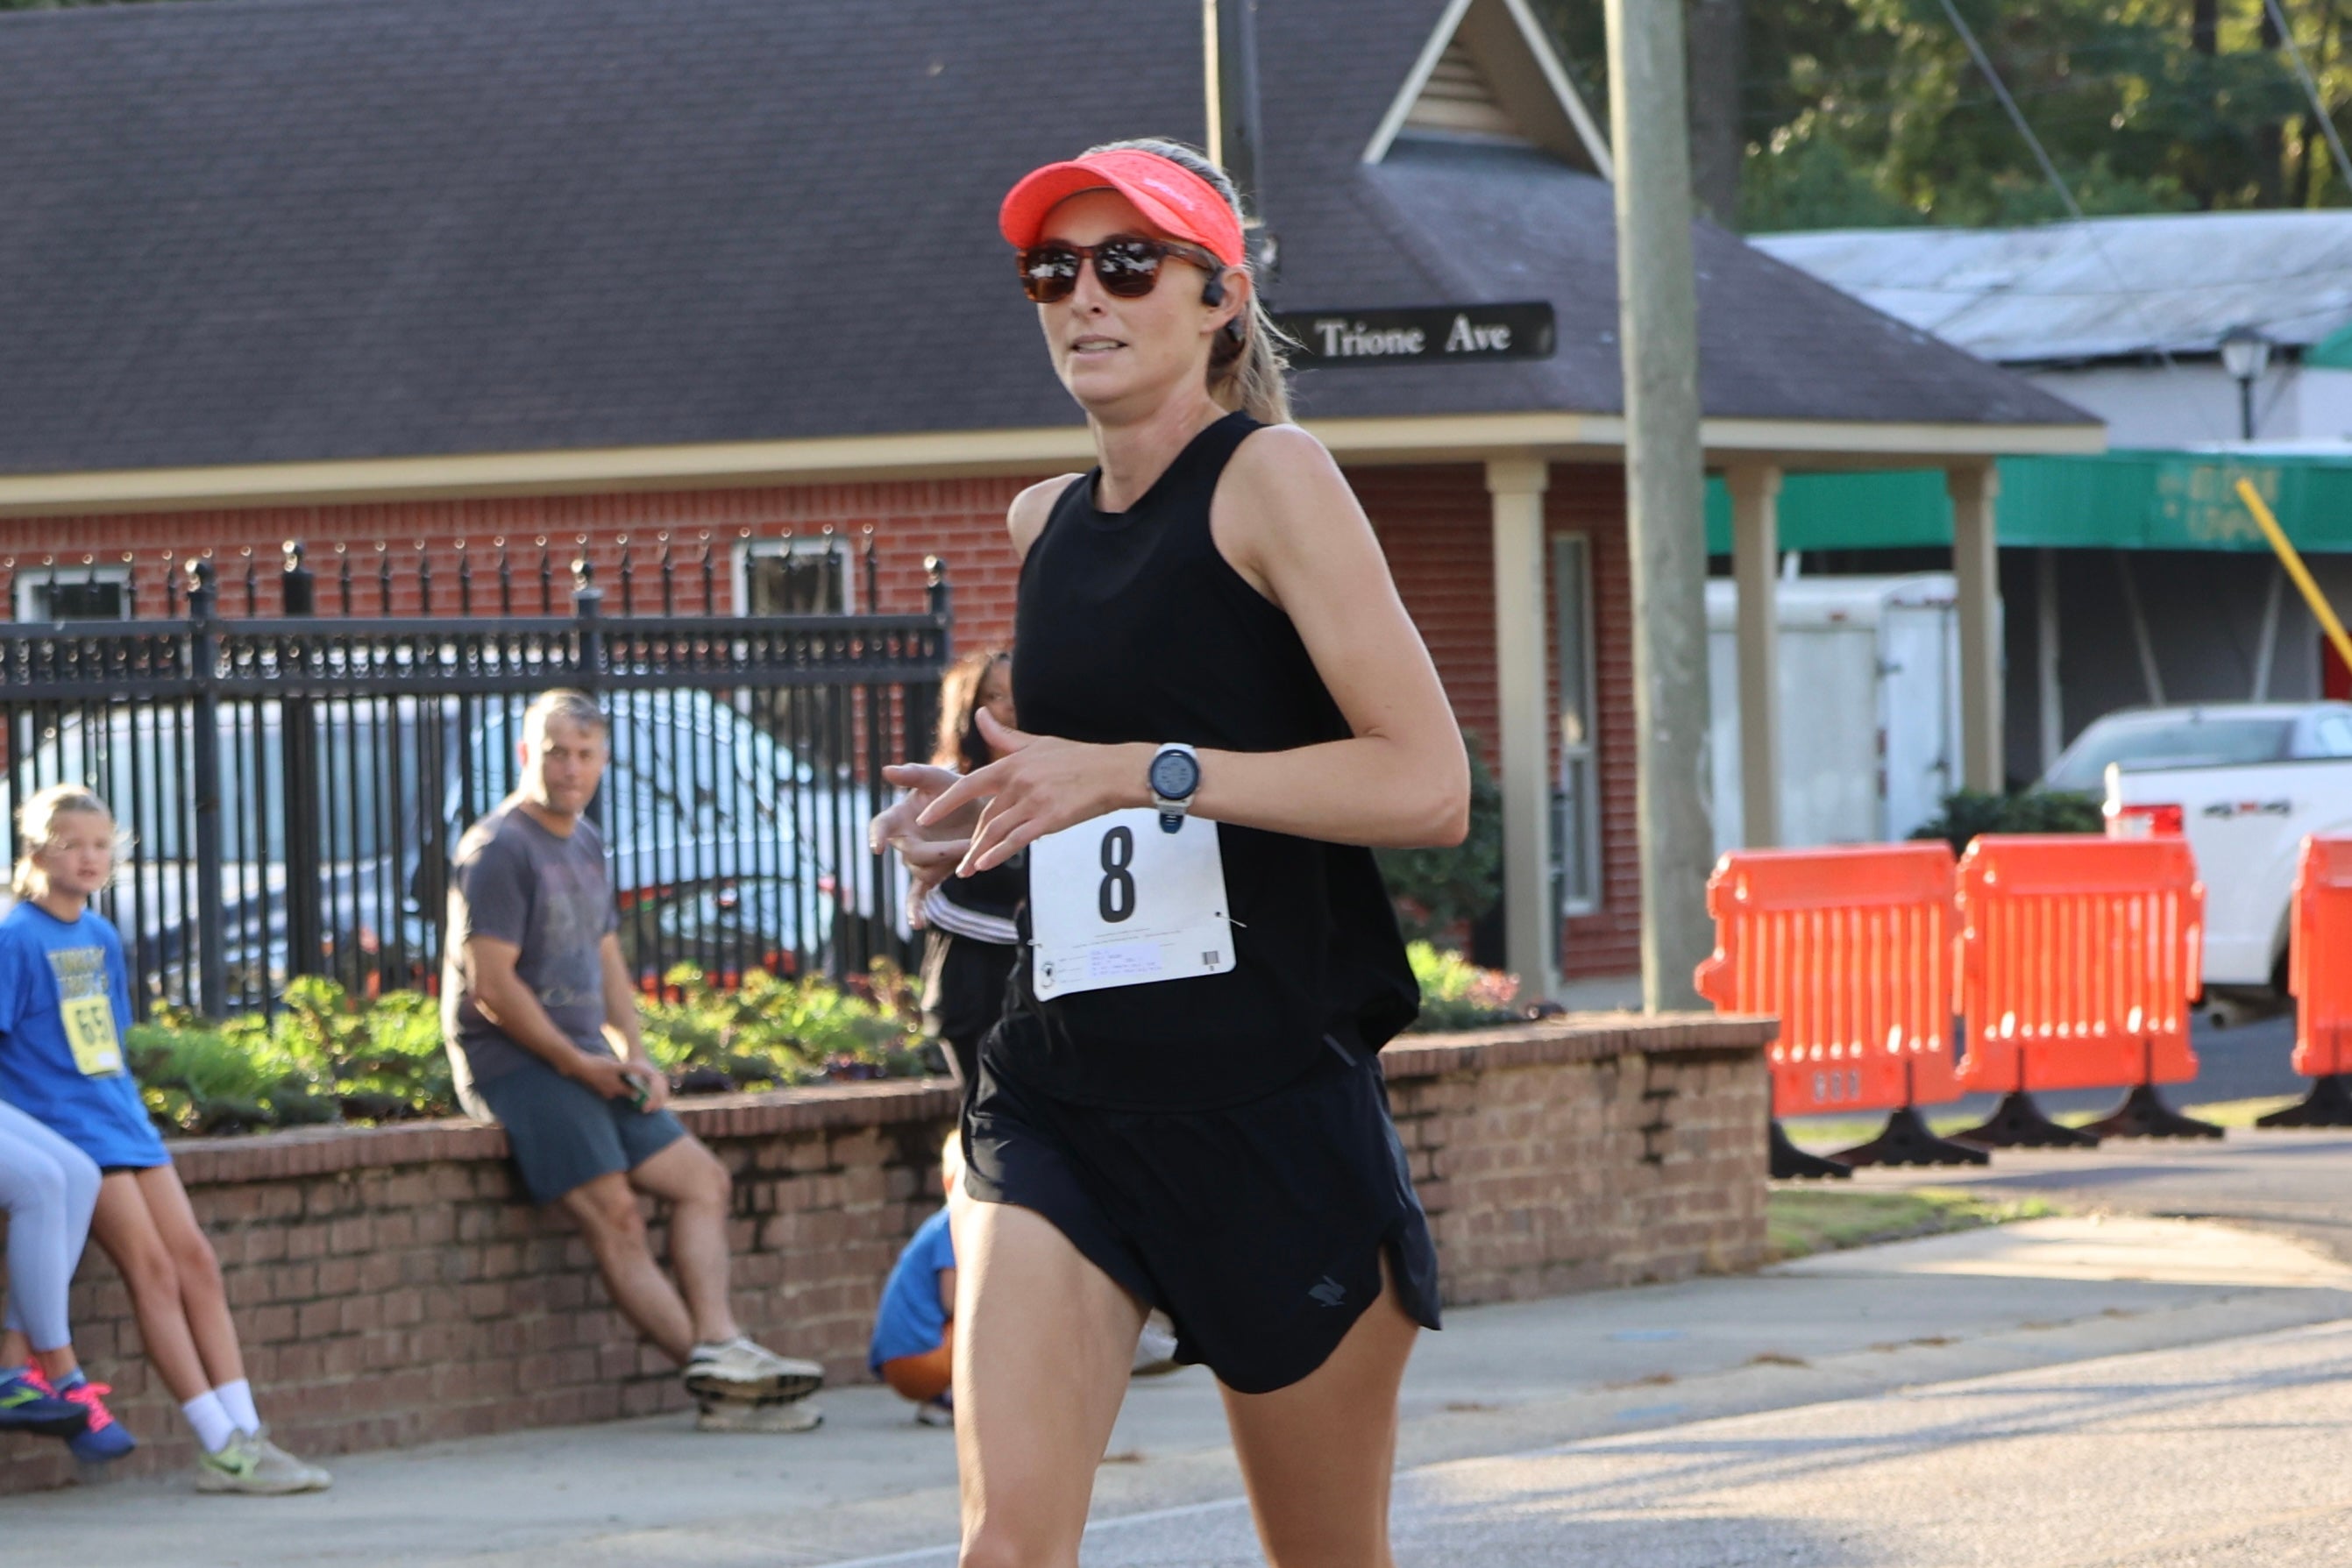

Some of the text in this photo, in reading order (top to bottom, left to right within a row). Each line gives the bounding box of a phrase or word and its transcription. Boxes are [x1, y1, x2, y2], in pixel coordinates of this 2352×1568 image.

[1315, 313, 1511, 357] Trione Ave
[1098, 826, 1136, 923] 8
